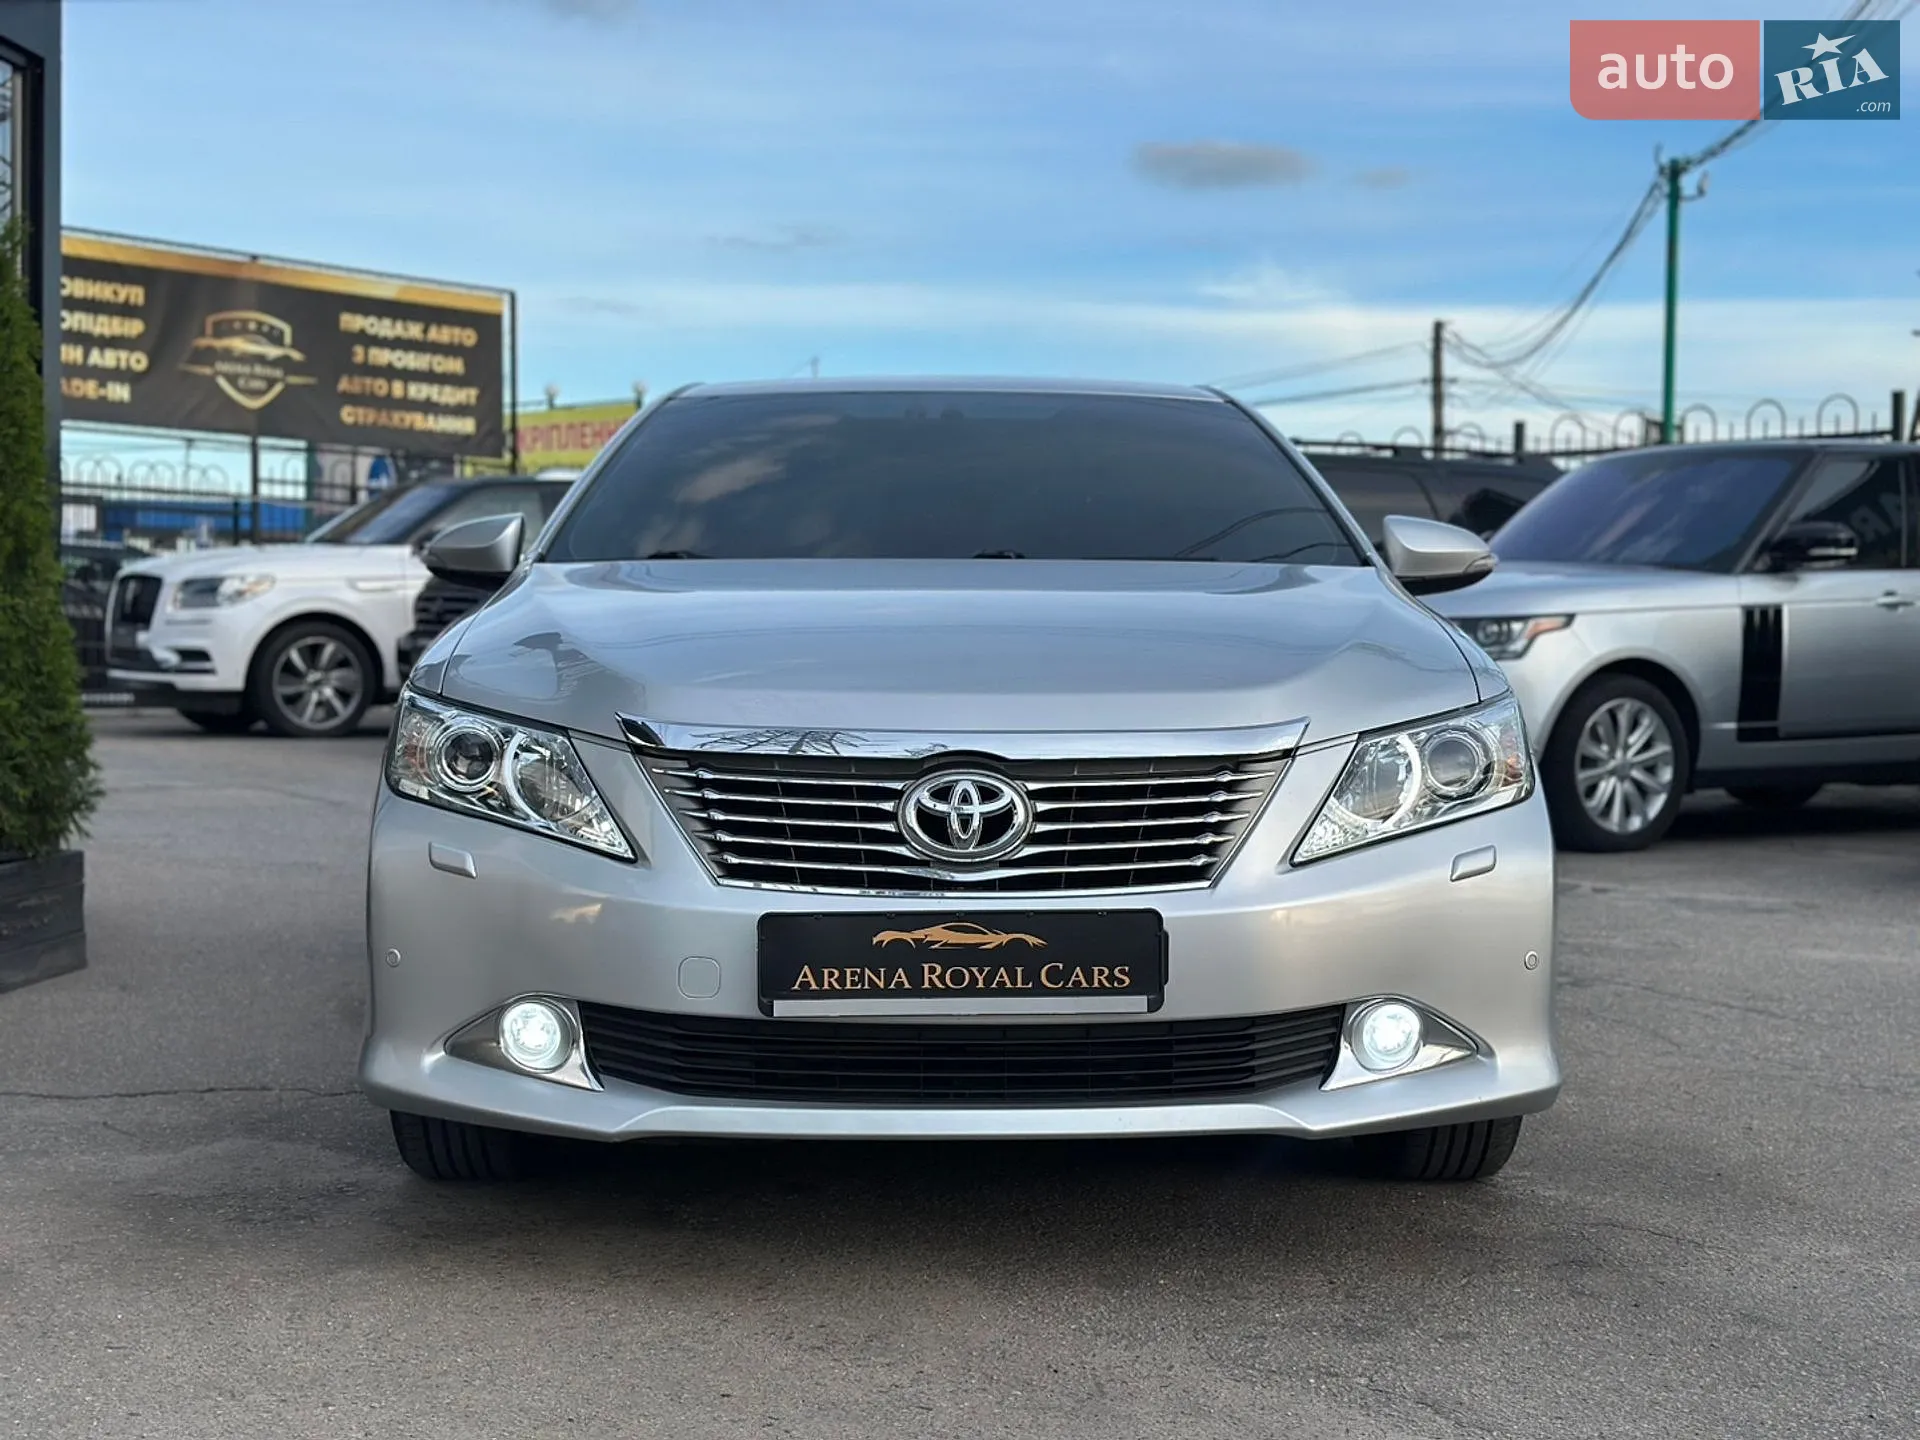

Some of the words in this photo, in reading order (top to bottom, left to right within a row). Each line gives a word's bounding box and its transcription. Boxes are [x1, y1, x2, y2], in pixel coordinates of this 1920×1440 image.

[339, 311, 425, 341] ПРОДАЖ
[426, 323, 478, 347] АВТО
[87, 346, 149, 373] АВТО
[337, 374, 389, 398] АВТО
[391, 379, 405, 400] В
[407, 380, 479, 407] КРЕДИТ
[791, 964, 913, 991] ARENA
[920, 962, 1033, 990] ROYAL
[1039, 961, 1132, 989] CARS
